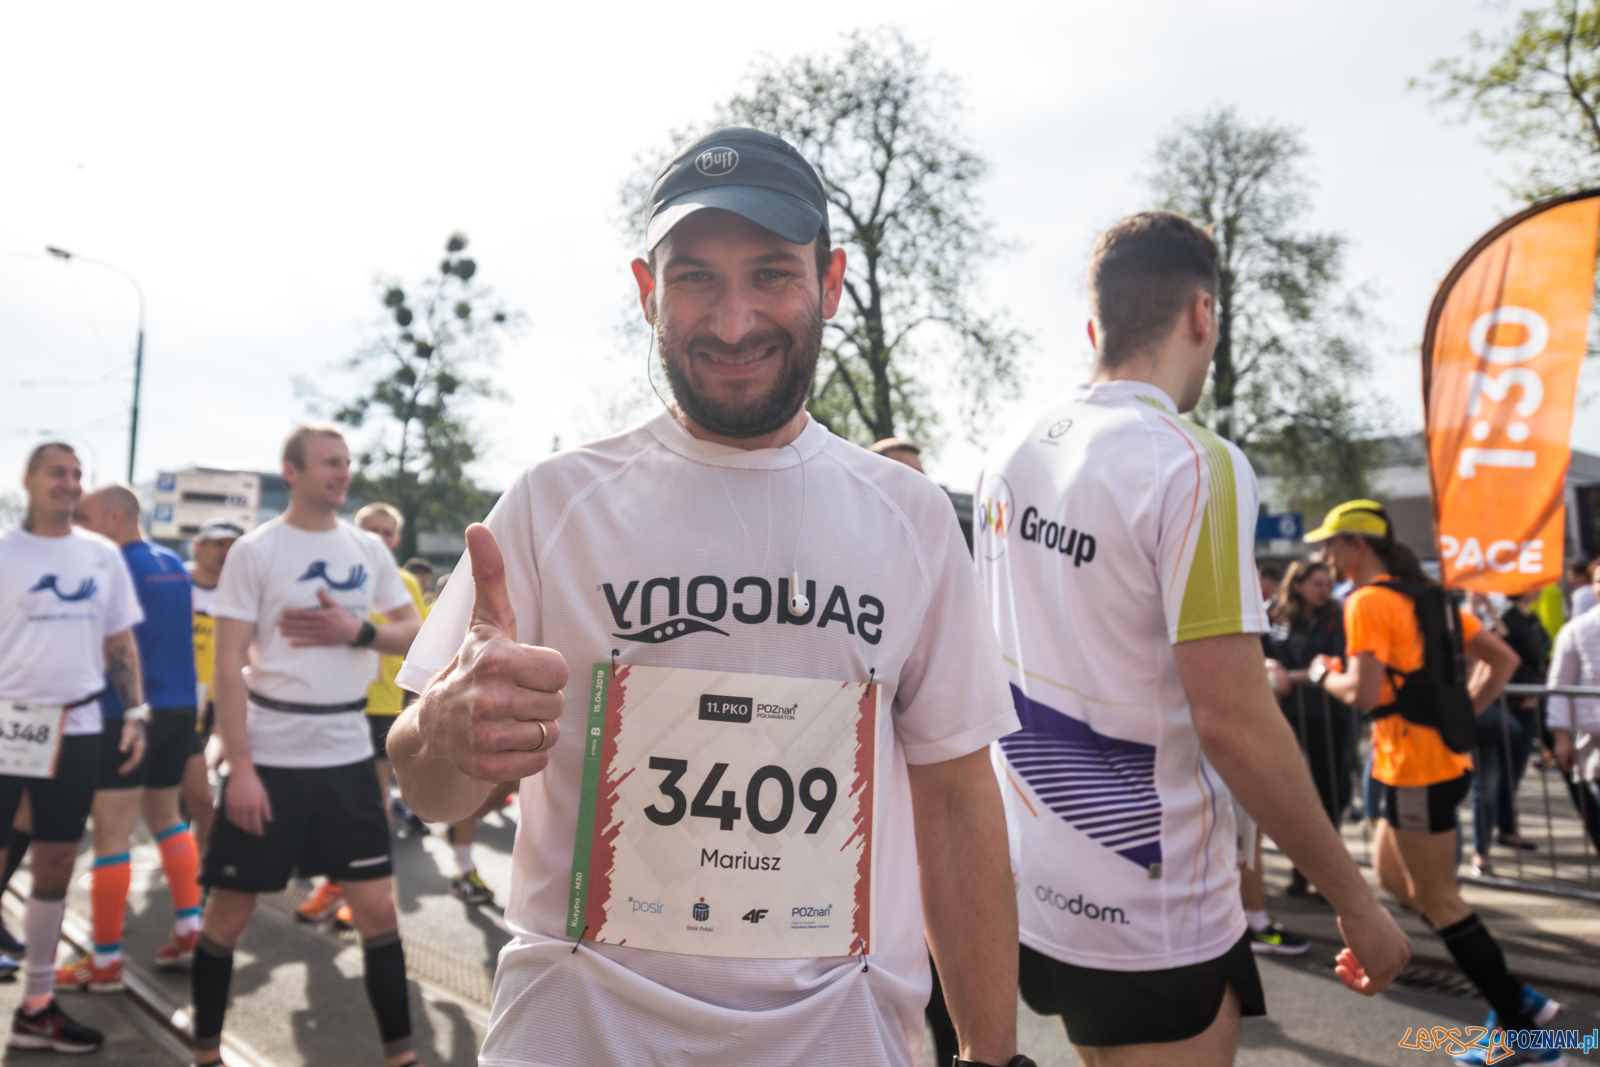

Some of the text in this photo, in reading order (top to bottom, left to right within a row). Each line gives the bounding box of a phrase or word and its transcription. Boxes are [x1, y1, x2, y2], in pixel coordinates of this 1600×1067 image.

[1457, 305, 1550, 480] 1:30
[1020, 505, 1096, 568] Group
[593, 669, 604, 713] 15.04.2018
[722, 703, 748, 716] PKO
[0, 721, 50, 745] 348
[590, 727, 601, 736] B
[643, 756, 838, 835] 3409
[700, 848, 781, 871] Mariusz
[575, 872, 583, 890] M30
[571, 897, 580, 927] Kutyba
[742, 909, 769, 924] 4F
